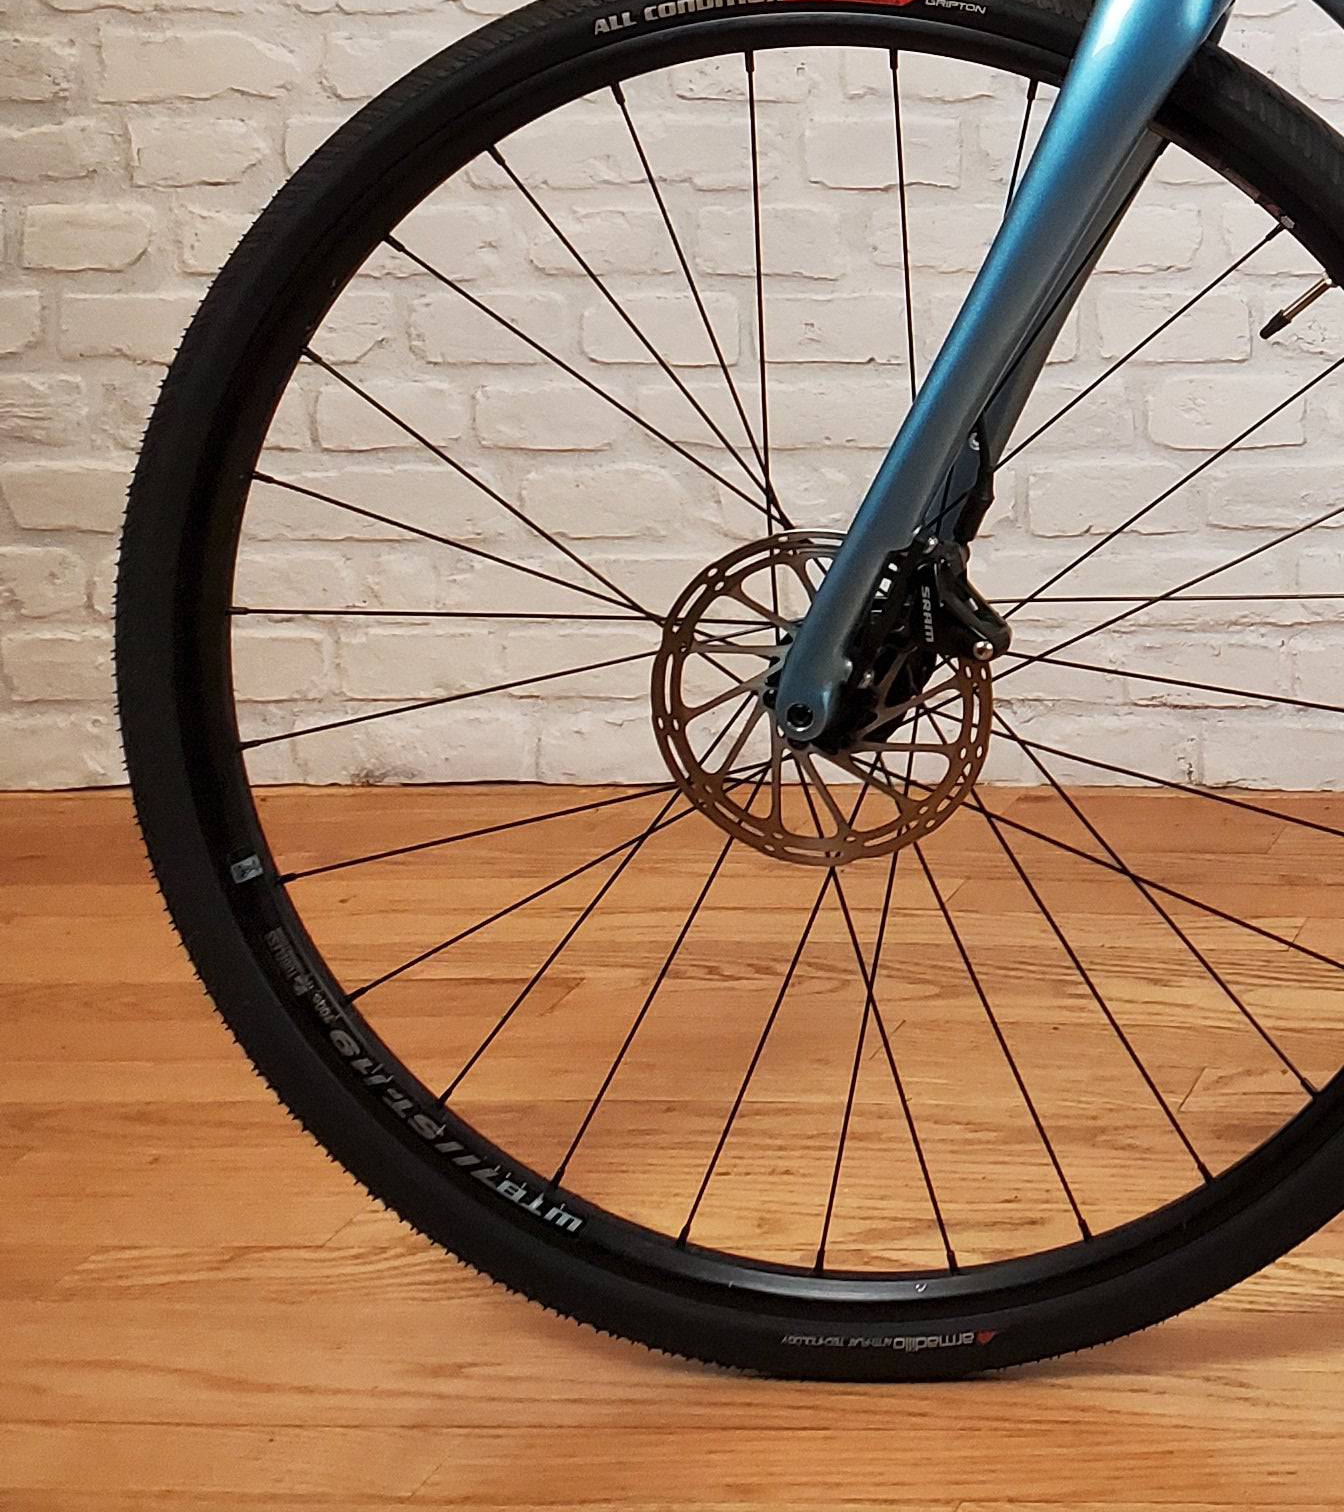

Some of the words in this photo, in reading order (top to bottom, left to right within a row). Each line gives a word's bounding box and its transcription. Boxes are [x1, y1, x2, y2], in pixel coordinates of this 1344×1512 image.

[593, 10, 637, 36] ALL
[920, 585, 935, 644] SRAM
[496, 1176, 584, 1234] WTB
[891, 1331, 975, 1354] armadillo
